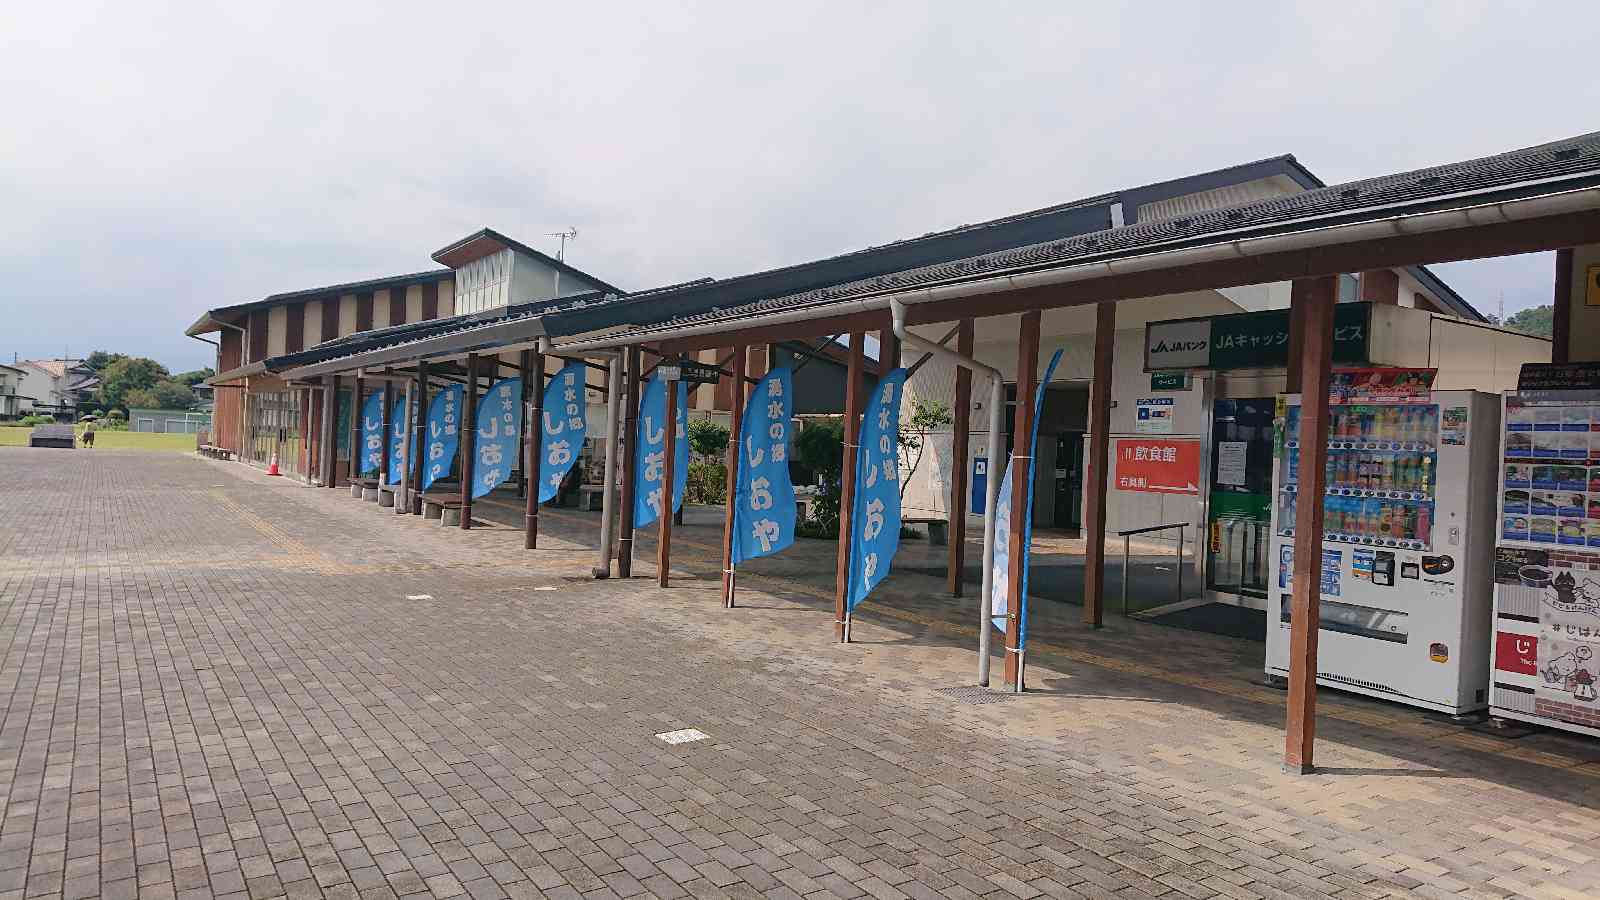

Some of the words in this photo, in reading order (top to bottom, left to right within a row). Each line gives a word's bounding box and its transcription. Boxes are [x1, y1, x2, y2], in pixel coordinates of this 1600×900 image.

[1170, 340, 1207, 352] JAバンク
[746, 434, 780, 552] しおや
[864, 448, 885, 593] しおや
